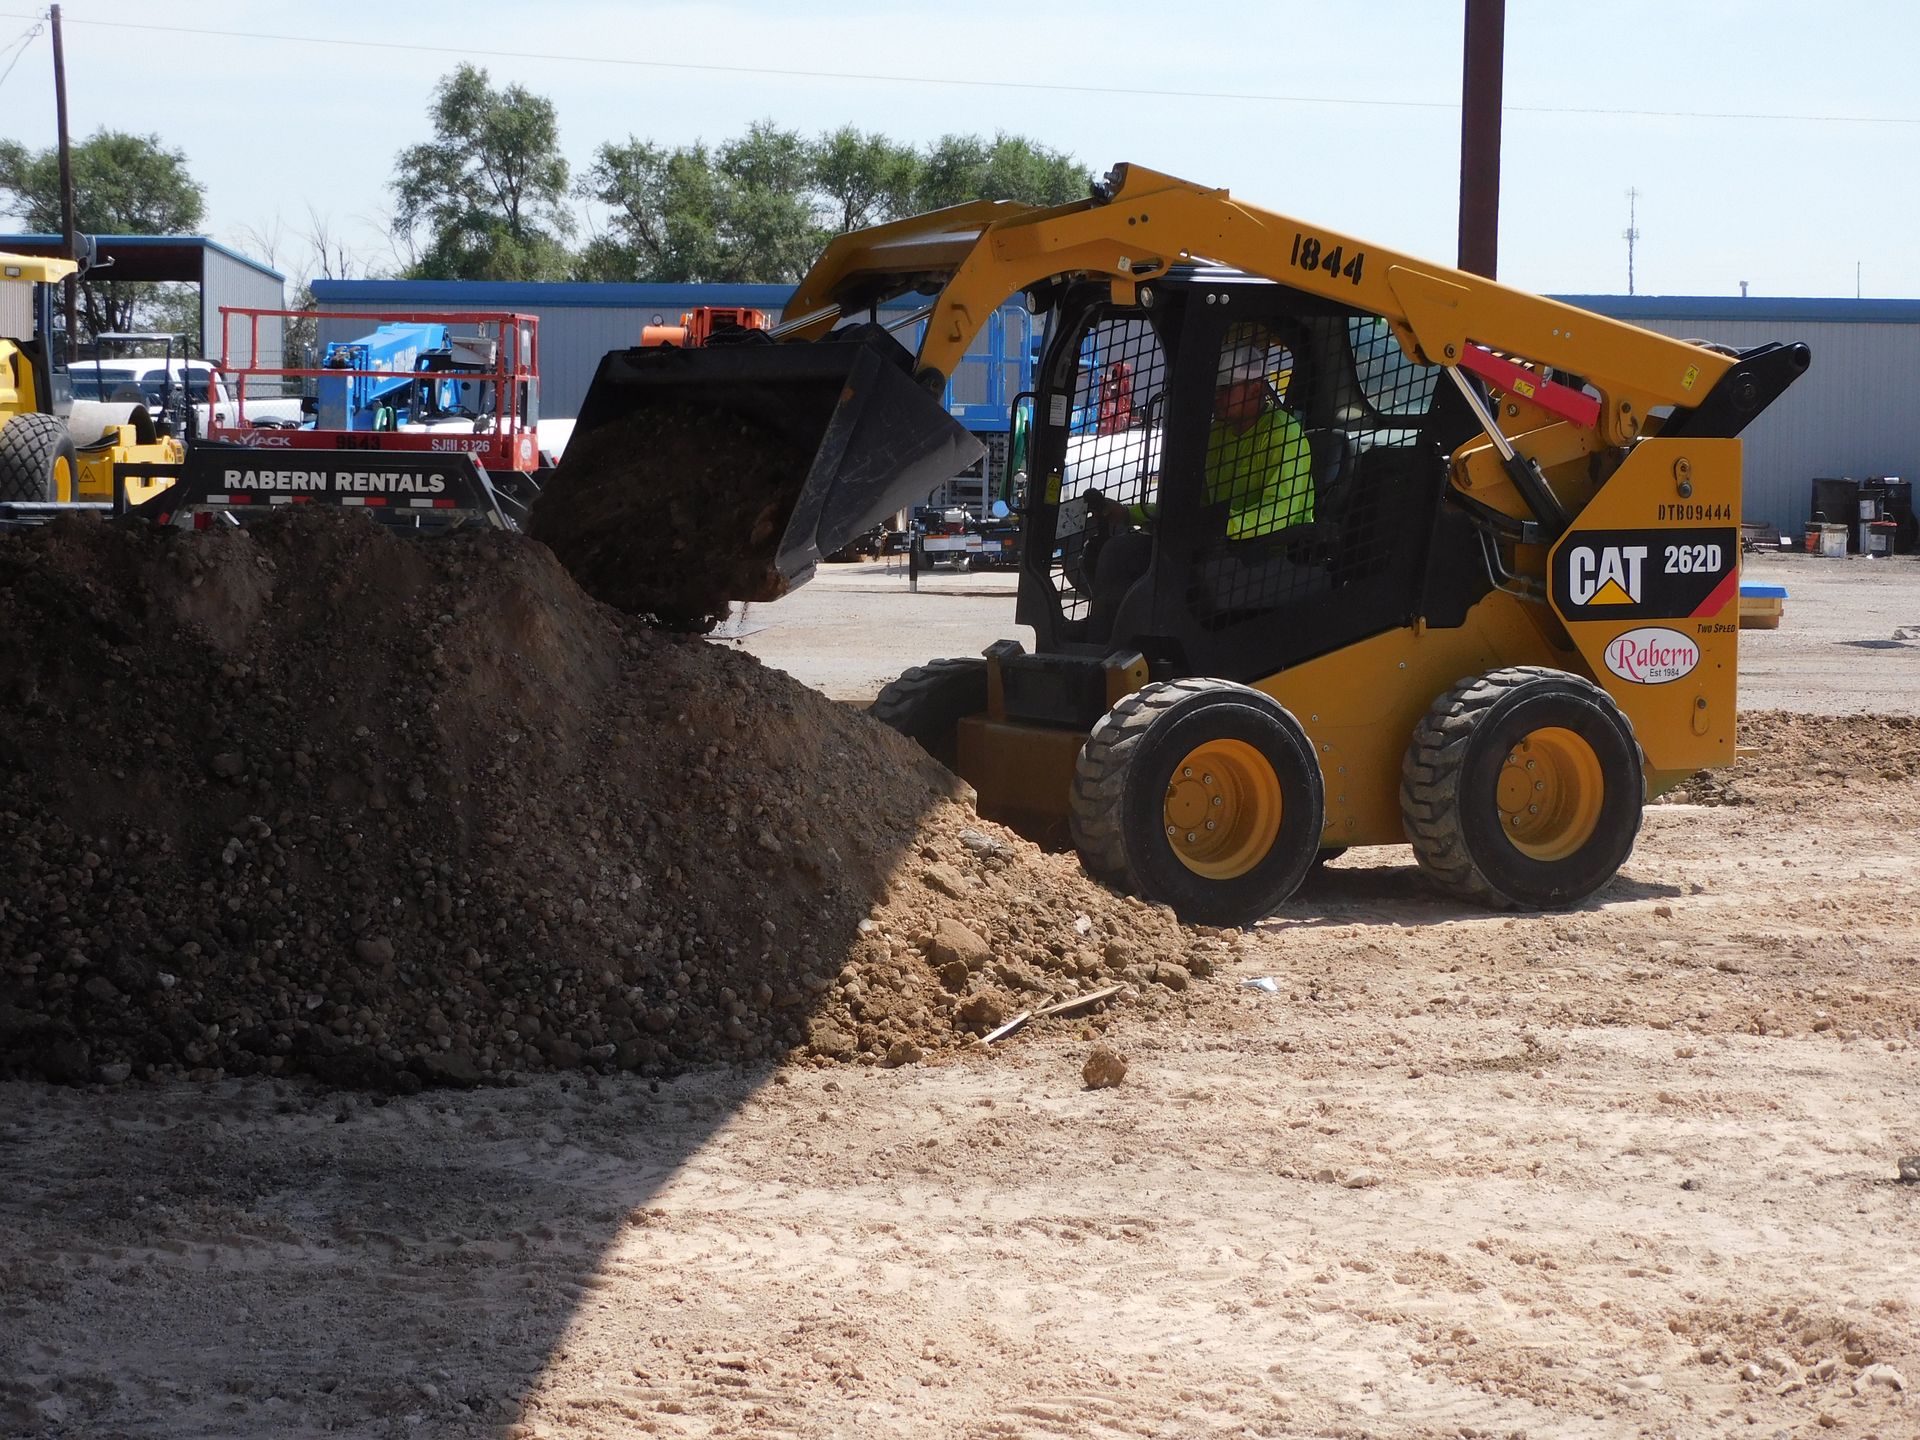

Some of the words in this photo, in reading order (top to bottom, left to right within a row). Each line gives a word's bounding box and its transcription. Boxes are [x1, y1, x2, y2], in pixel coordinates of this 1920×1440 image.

[1290, 233, 1364, 286] 1844
[224, 470, 327, 490] RABERN
[335, 471, 445, 492] RENTALS
[1658, 504, 1731, 521] DTB09444
[1569, 546, 1648, 606] CAT
[1664, 545, 1722, 573] 262D
[1611, 639, 1694, 681] Rabern
[1650, 668, 1662, 677] Est
[1664, 667, 1680, 677] 1984
